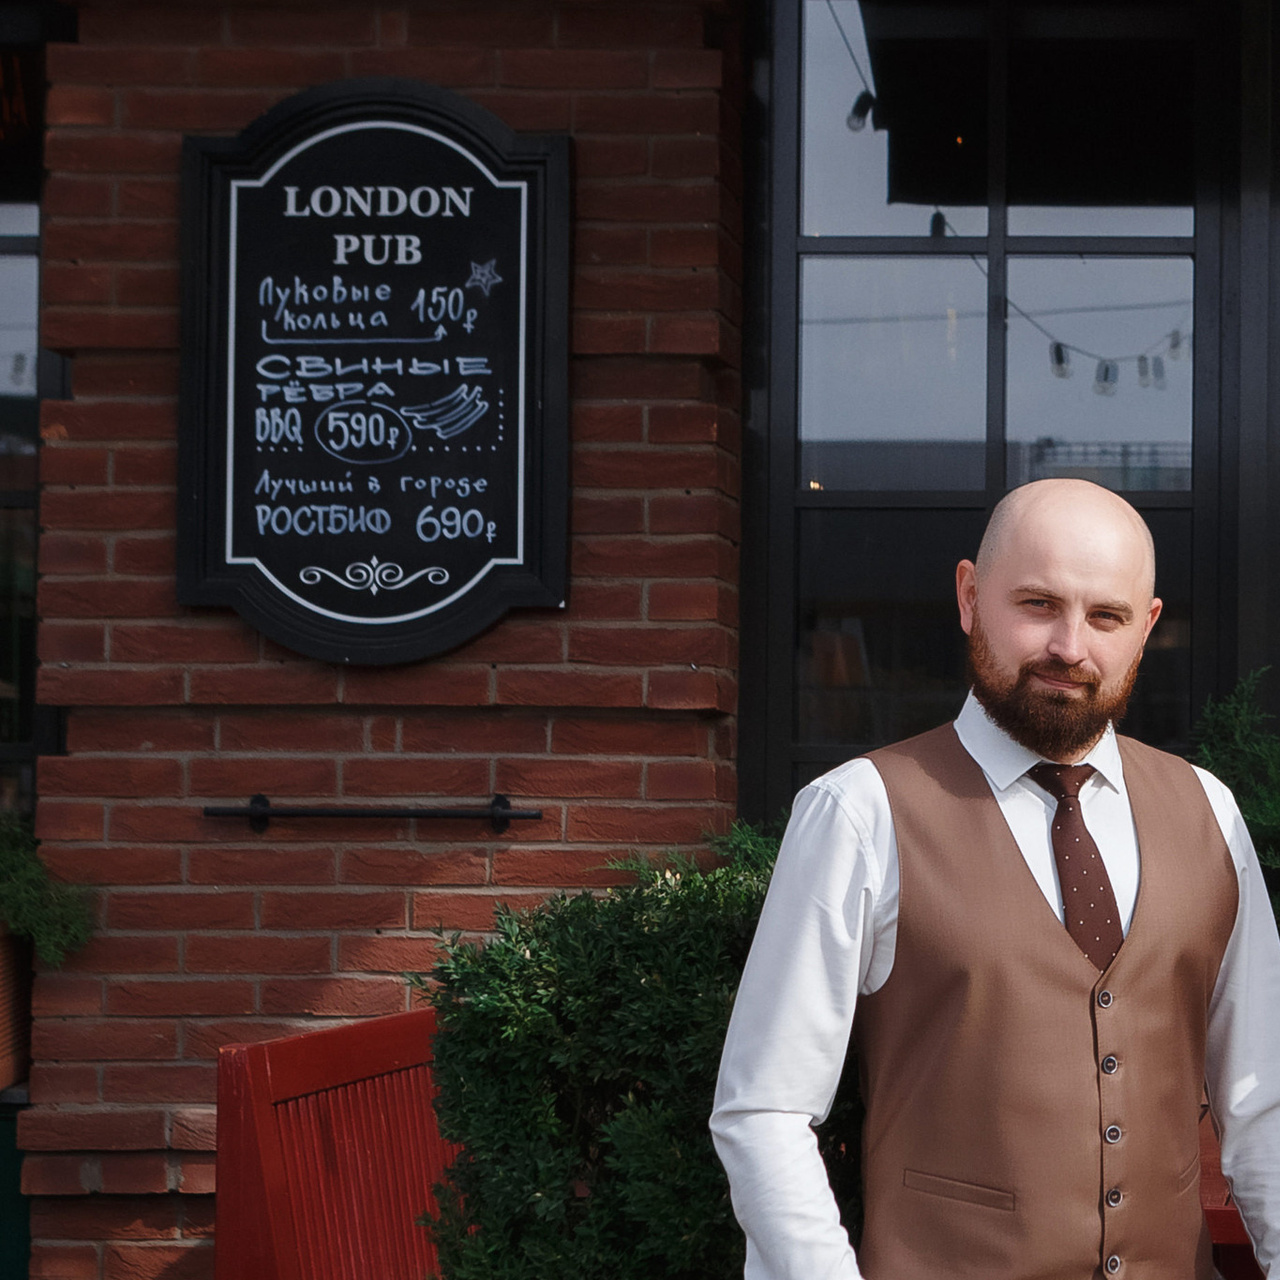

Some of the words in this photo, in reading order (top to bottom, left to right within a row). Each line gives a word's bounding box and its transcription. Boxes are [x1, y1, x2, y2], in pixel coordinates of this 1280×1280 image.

[283, 186, 474, 218] LONDON
[333, 234, 423, 266] PUB
[258, 275, 392, 322] Луковые
[283, 308, 389, 332] кольца
[255, 354, 492, 380] СВИНЫЕ
[256, 380, 396, 404] РЁБРА
[255, 407, 304, 445] BBQ
[254, 468, 354, 501] Лучший
[400, 476, 488, 499] городе
[255, 504, 392, 536] РОСТБИФ
